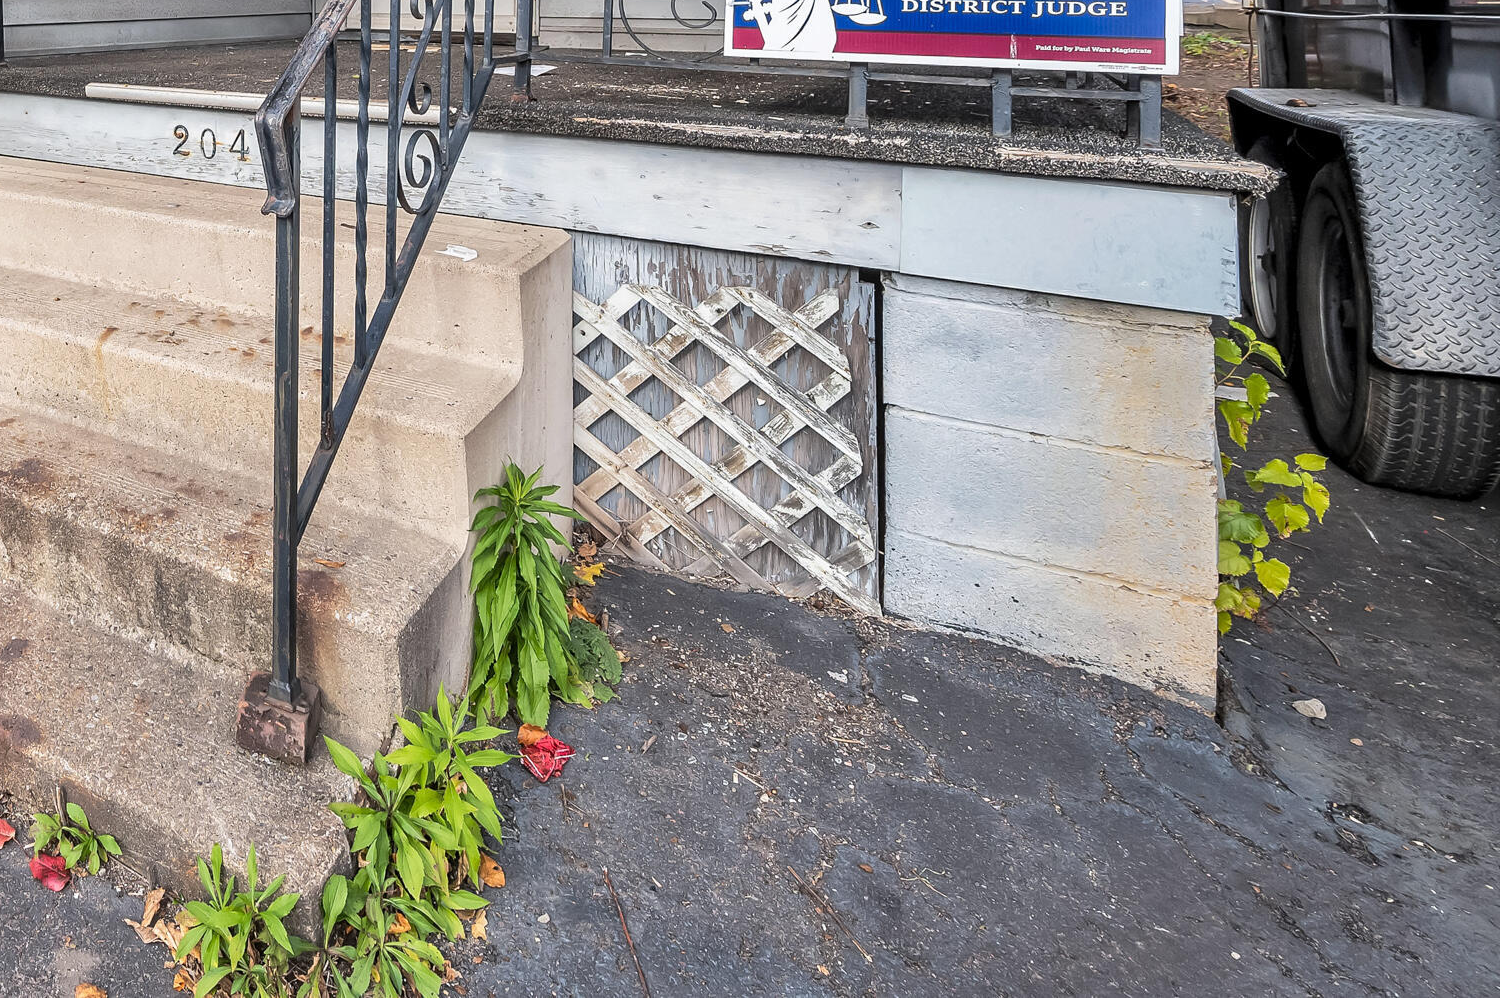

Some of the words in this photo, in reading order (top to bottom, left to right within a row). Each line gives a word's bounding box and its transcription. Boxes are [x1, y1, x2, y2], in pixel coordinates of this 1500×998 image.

[1031, 0, 1128, 18] JUDGE
[1064, 44, 1073, 52] by
[172, 124, 250, 161] 204
